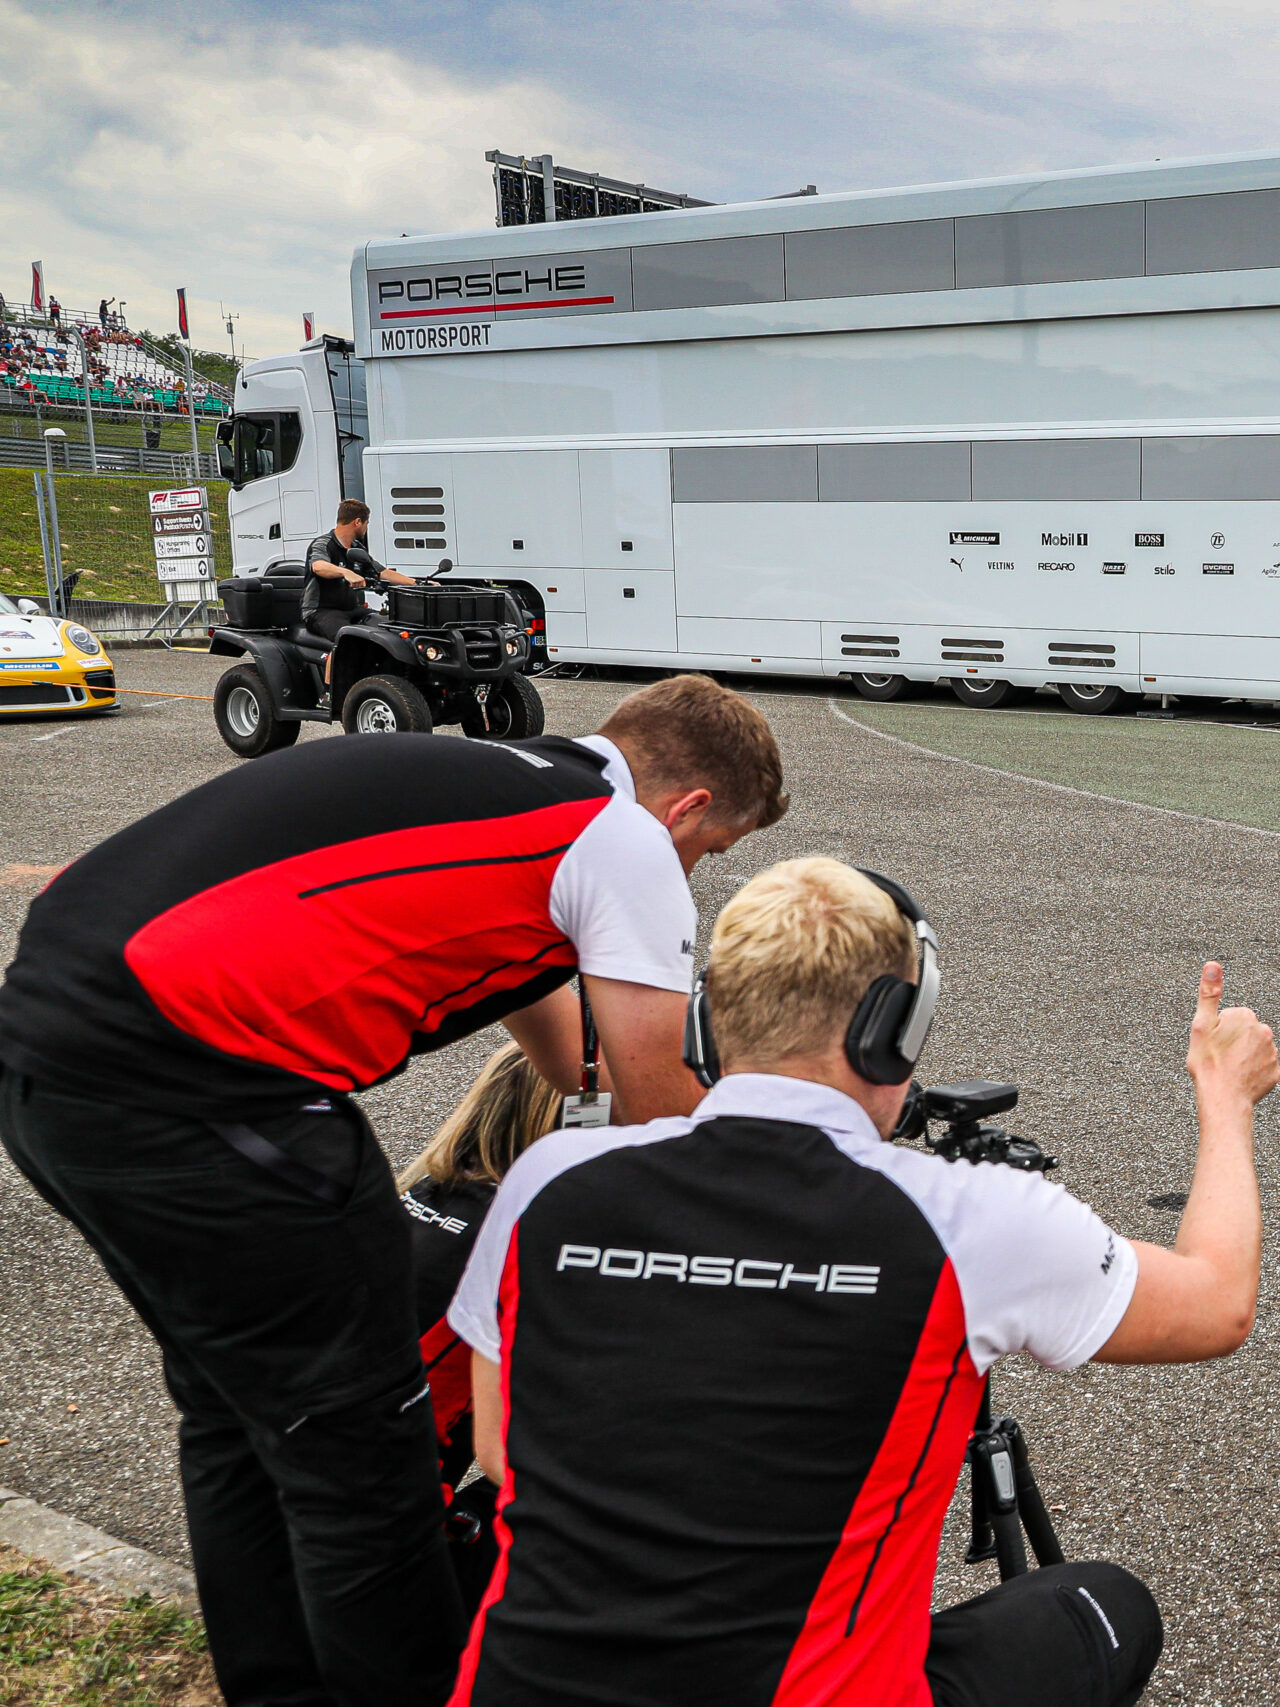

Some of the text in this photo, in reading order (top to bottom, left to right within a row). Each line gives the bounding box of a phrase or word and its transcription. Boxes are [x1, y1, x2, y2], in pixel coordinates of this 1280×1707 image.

[378, 266, 586, 304] PORSCHE
[381, 324, 491, 351] MOTORSPORT
[1041, 533, 1074, 546] Mobil
[1213, 536, 1223, 545] ZF
[988, 562, 1014, 570] VELTINS
[1038, 562, 1075, 571] RECARO
[1262, 568, 1277, 576] Agility
[556, 1244, 881, 1294] PORSCHE
